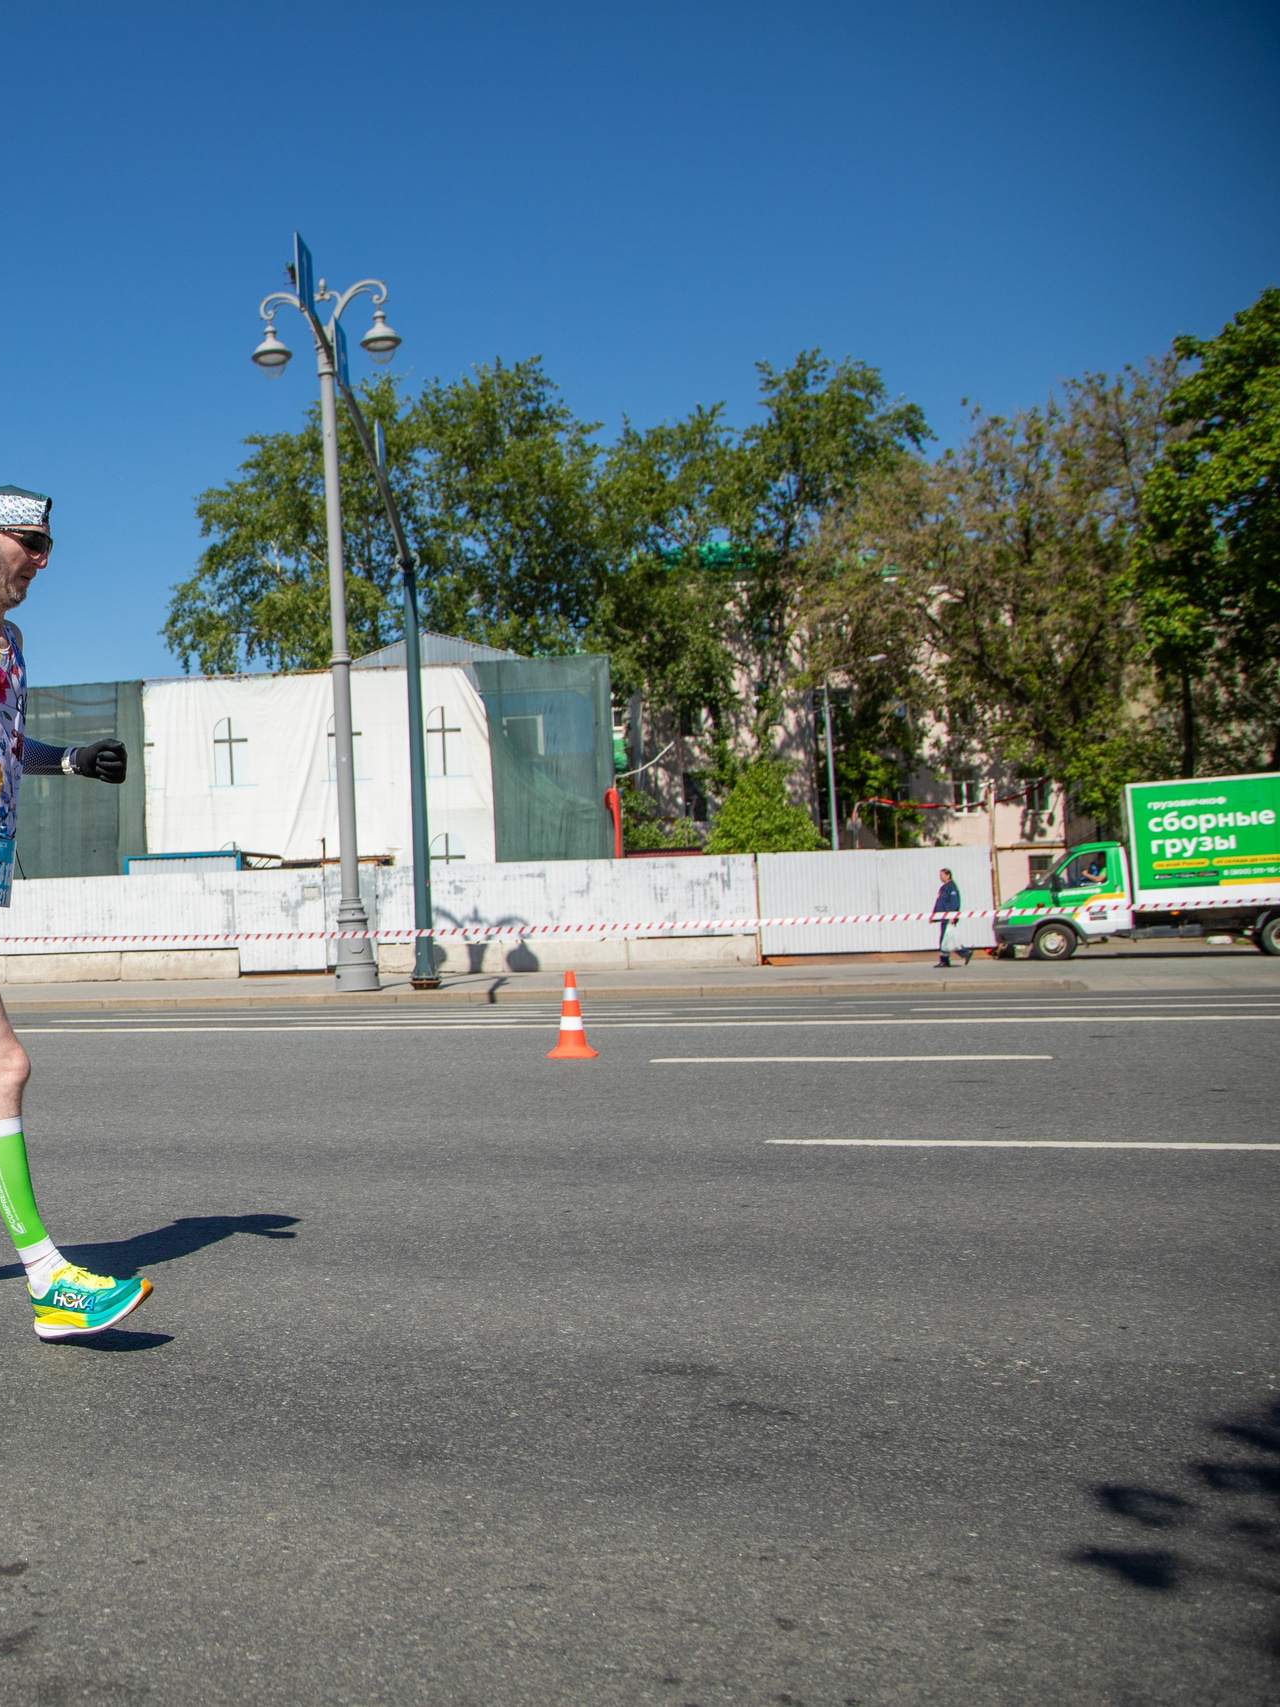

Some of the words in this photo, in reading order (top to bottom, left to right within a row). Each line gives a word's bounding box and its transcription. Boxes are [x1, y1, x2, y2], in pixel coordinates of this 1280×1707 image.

[1148, 809, 1276, 834] сборные
[1150, 834, 1237, 858] грузы
[53, 1291, 96, 1310] HOKA
